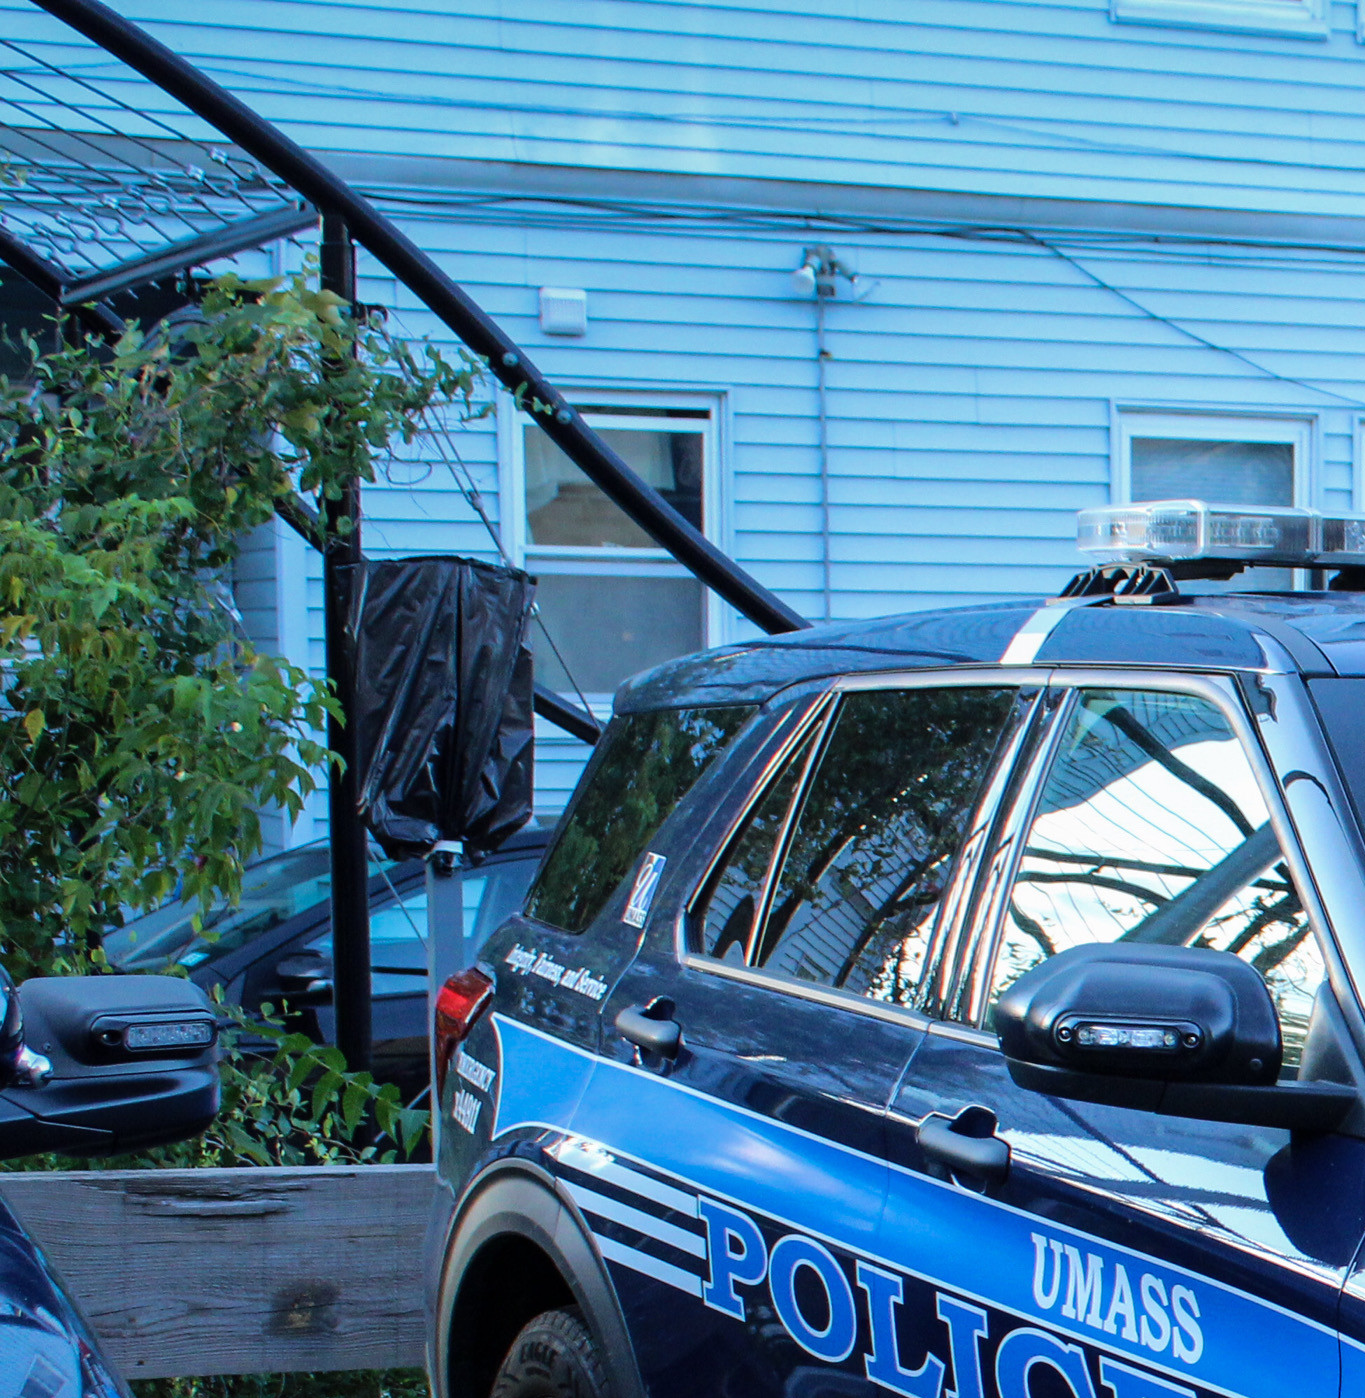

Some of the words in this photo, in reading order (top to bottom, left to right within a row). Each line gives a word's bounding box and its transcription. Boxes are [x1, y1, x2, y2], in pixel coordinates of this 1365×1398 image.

[560, 967, 585, 989] and
[574, 969, 608, 1000] Service
[1029, 1232, 1204, 1364] UMASS
